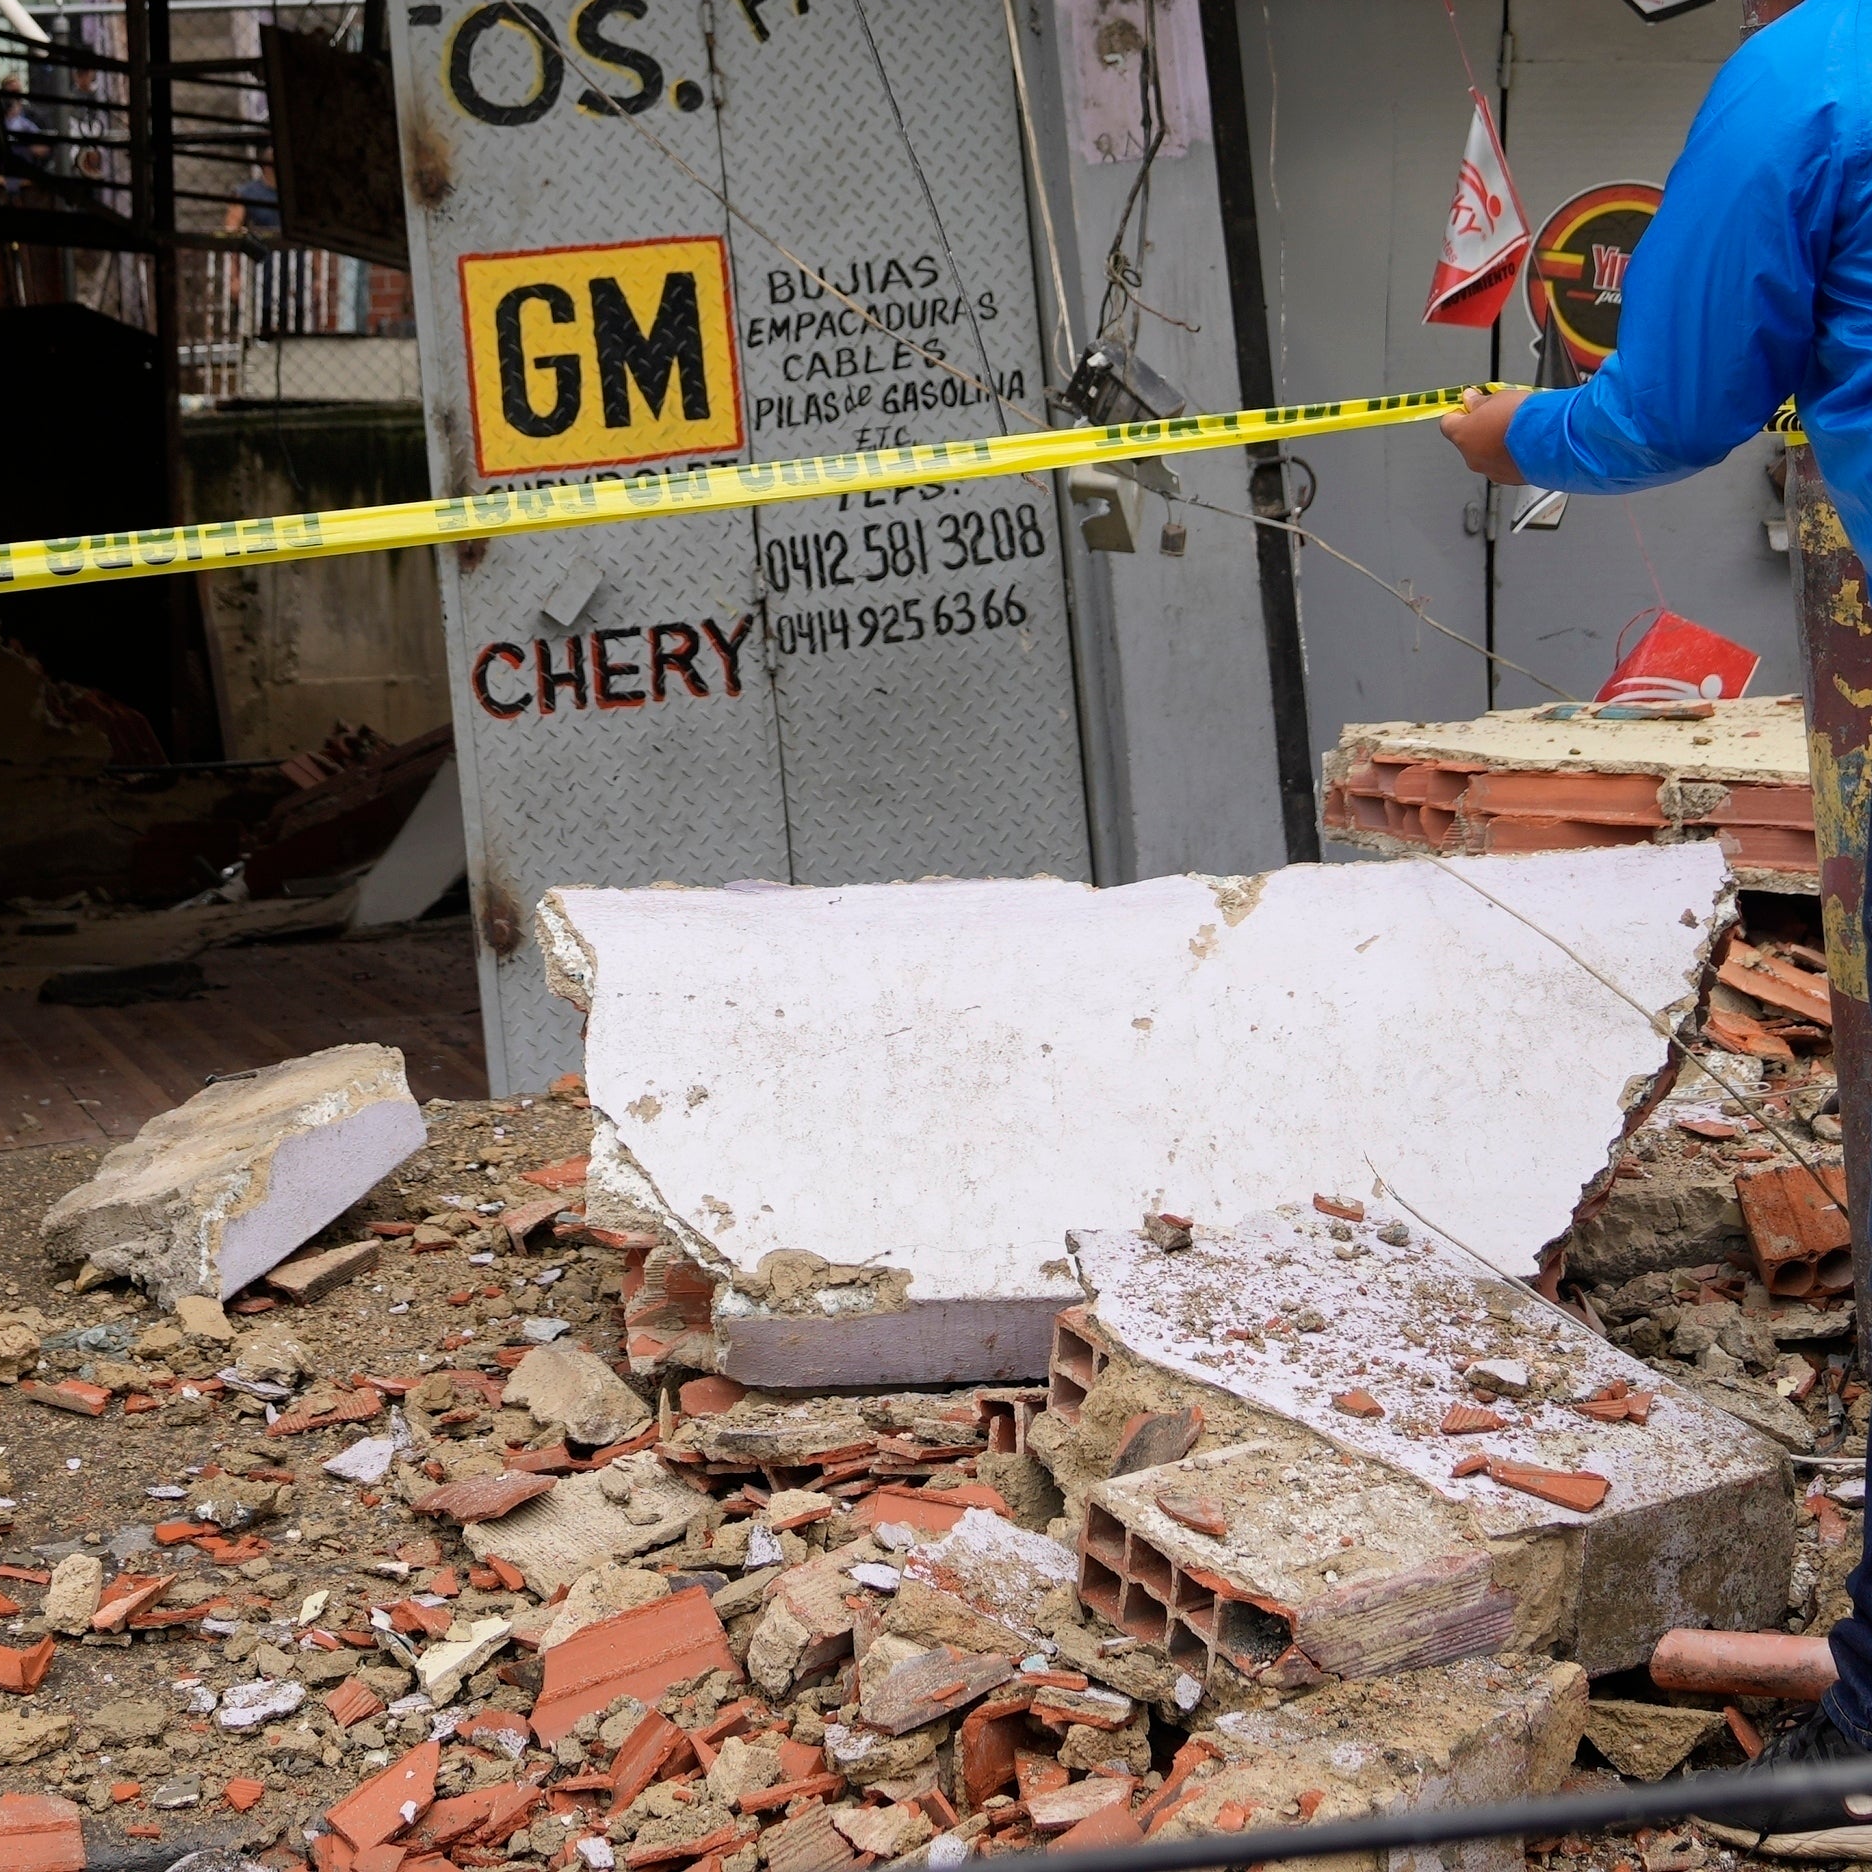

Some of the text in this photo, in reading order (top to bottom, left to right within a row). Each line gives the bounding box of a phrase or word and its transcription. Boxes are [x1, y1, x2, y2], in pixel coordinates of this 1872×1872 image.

[767, 255, 939, 304] BUJIAS
[747, 291, 999, 348] EMPACADURAS
[495, 271, 712, 438] GM
[783, 338, 947, 381] CABLES
[755, 370, 1025, 430] PILAS de GASOLINA
[766, 503, 1045, 592] 0412 581 3208
[778, 583, 1027, 655] 0414 925 6366
[472, 615, 753, 721] CHERY
